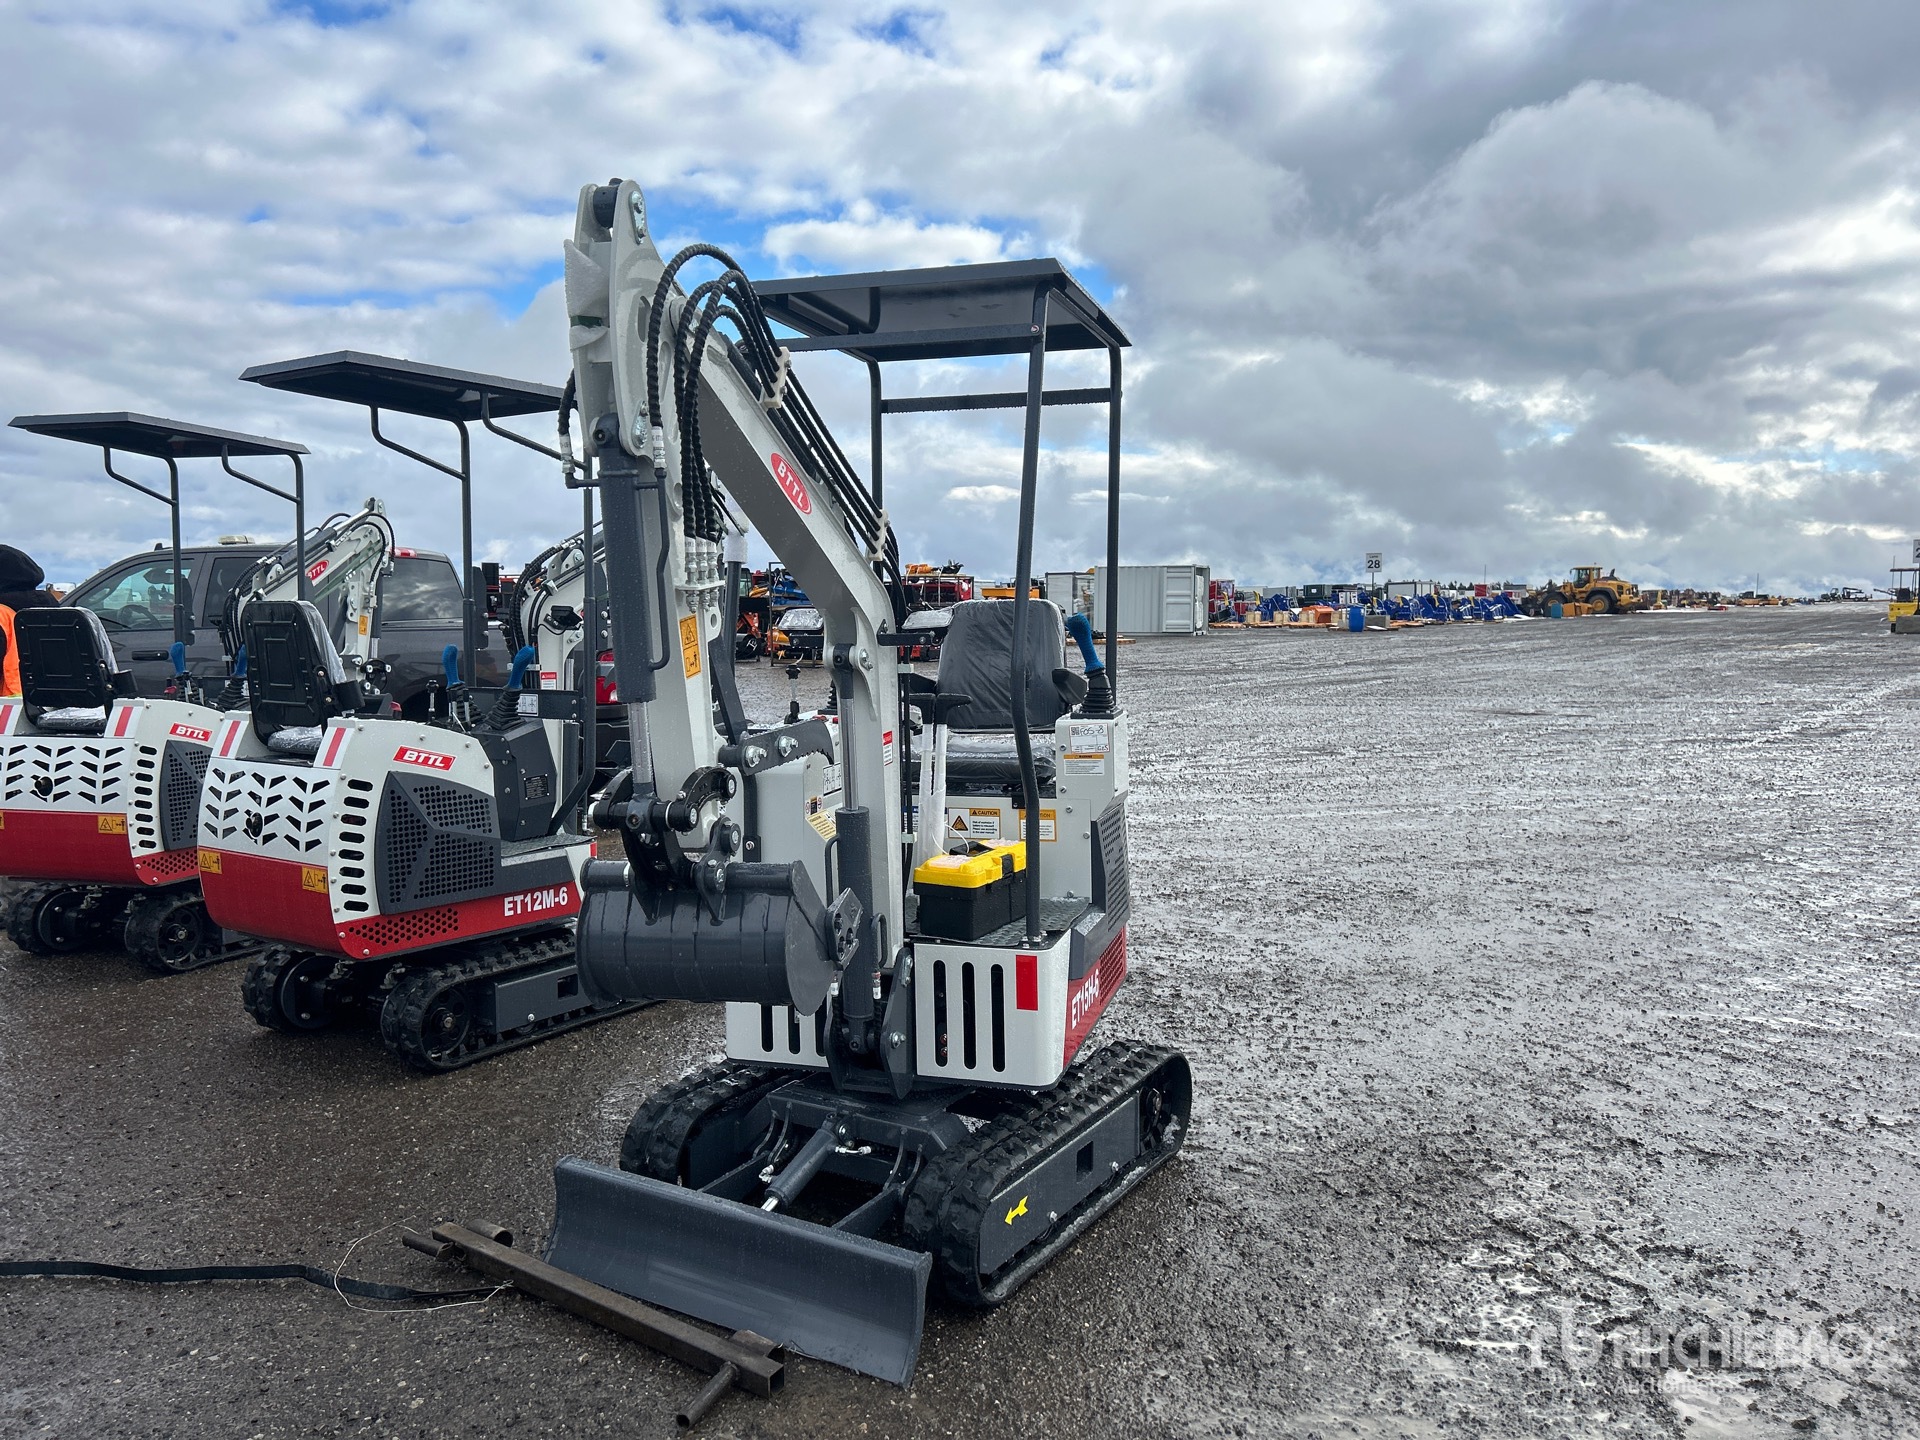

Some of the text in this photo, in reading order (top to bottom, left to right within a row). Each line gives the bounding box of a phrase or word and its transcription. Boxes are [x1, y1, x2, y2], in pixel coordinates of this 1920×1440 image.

[777, 461, 804, 508] BTTL
[1367, 559, 1381, 569] 28
[176, 725, 206, 739] BTTL
[402, 750, 445, 767] BTTL
[504, 886, 568, 917] ET12M-6
[1071, 968, 1099, 1030] ET15H-6
